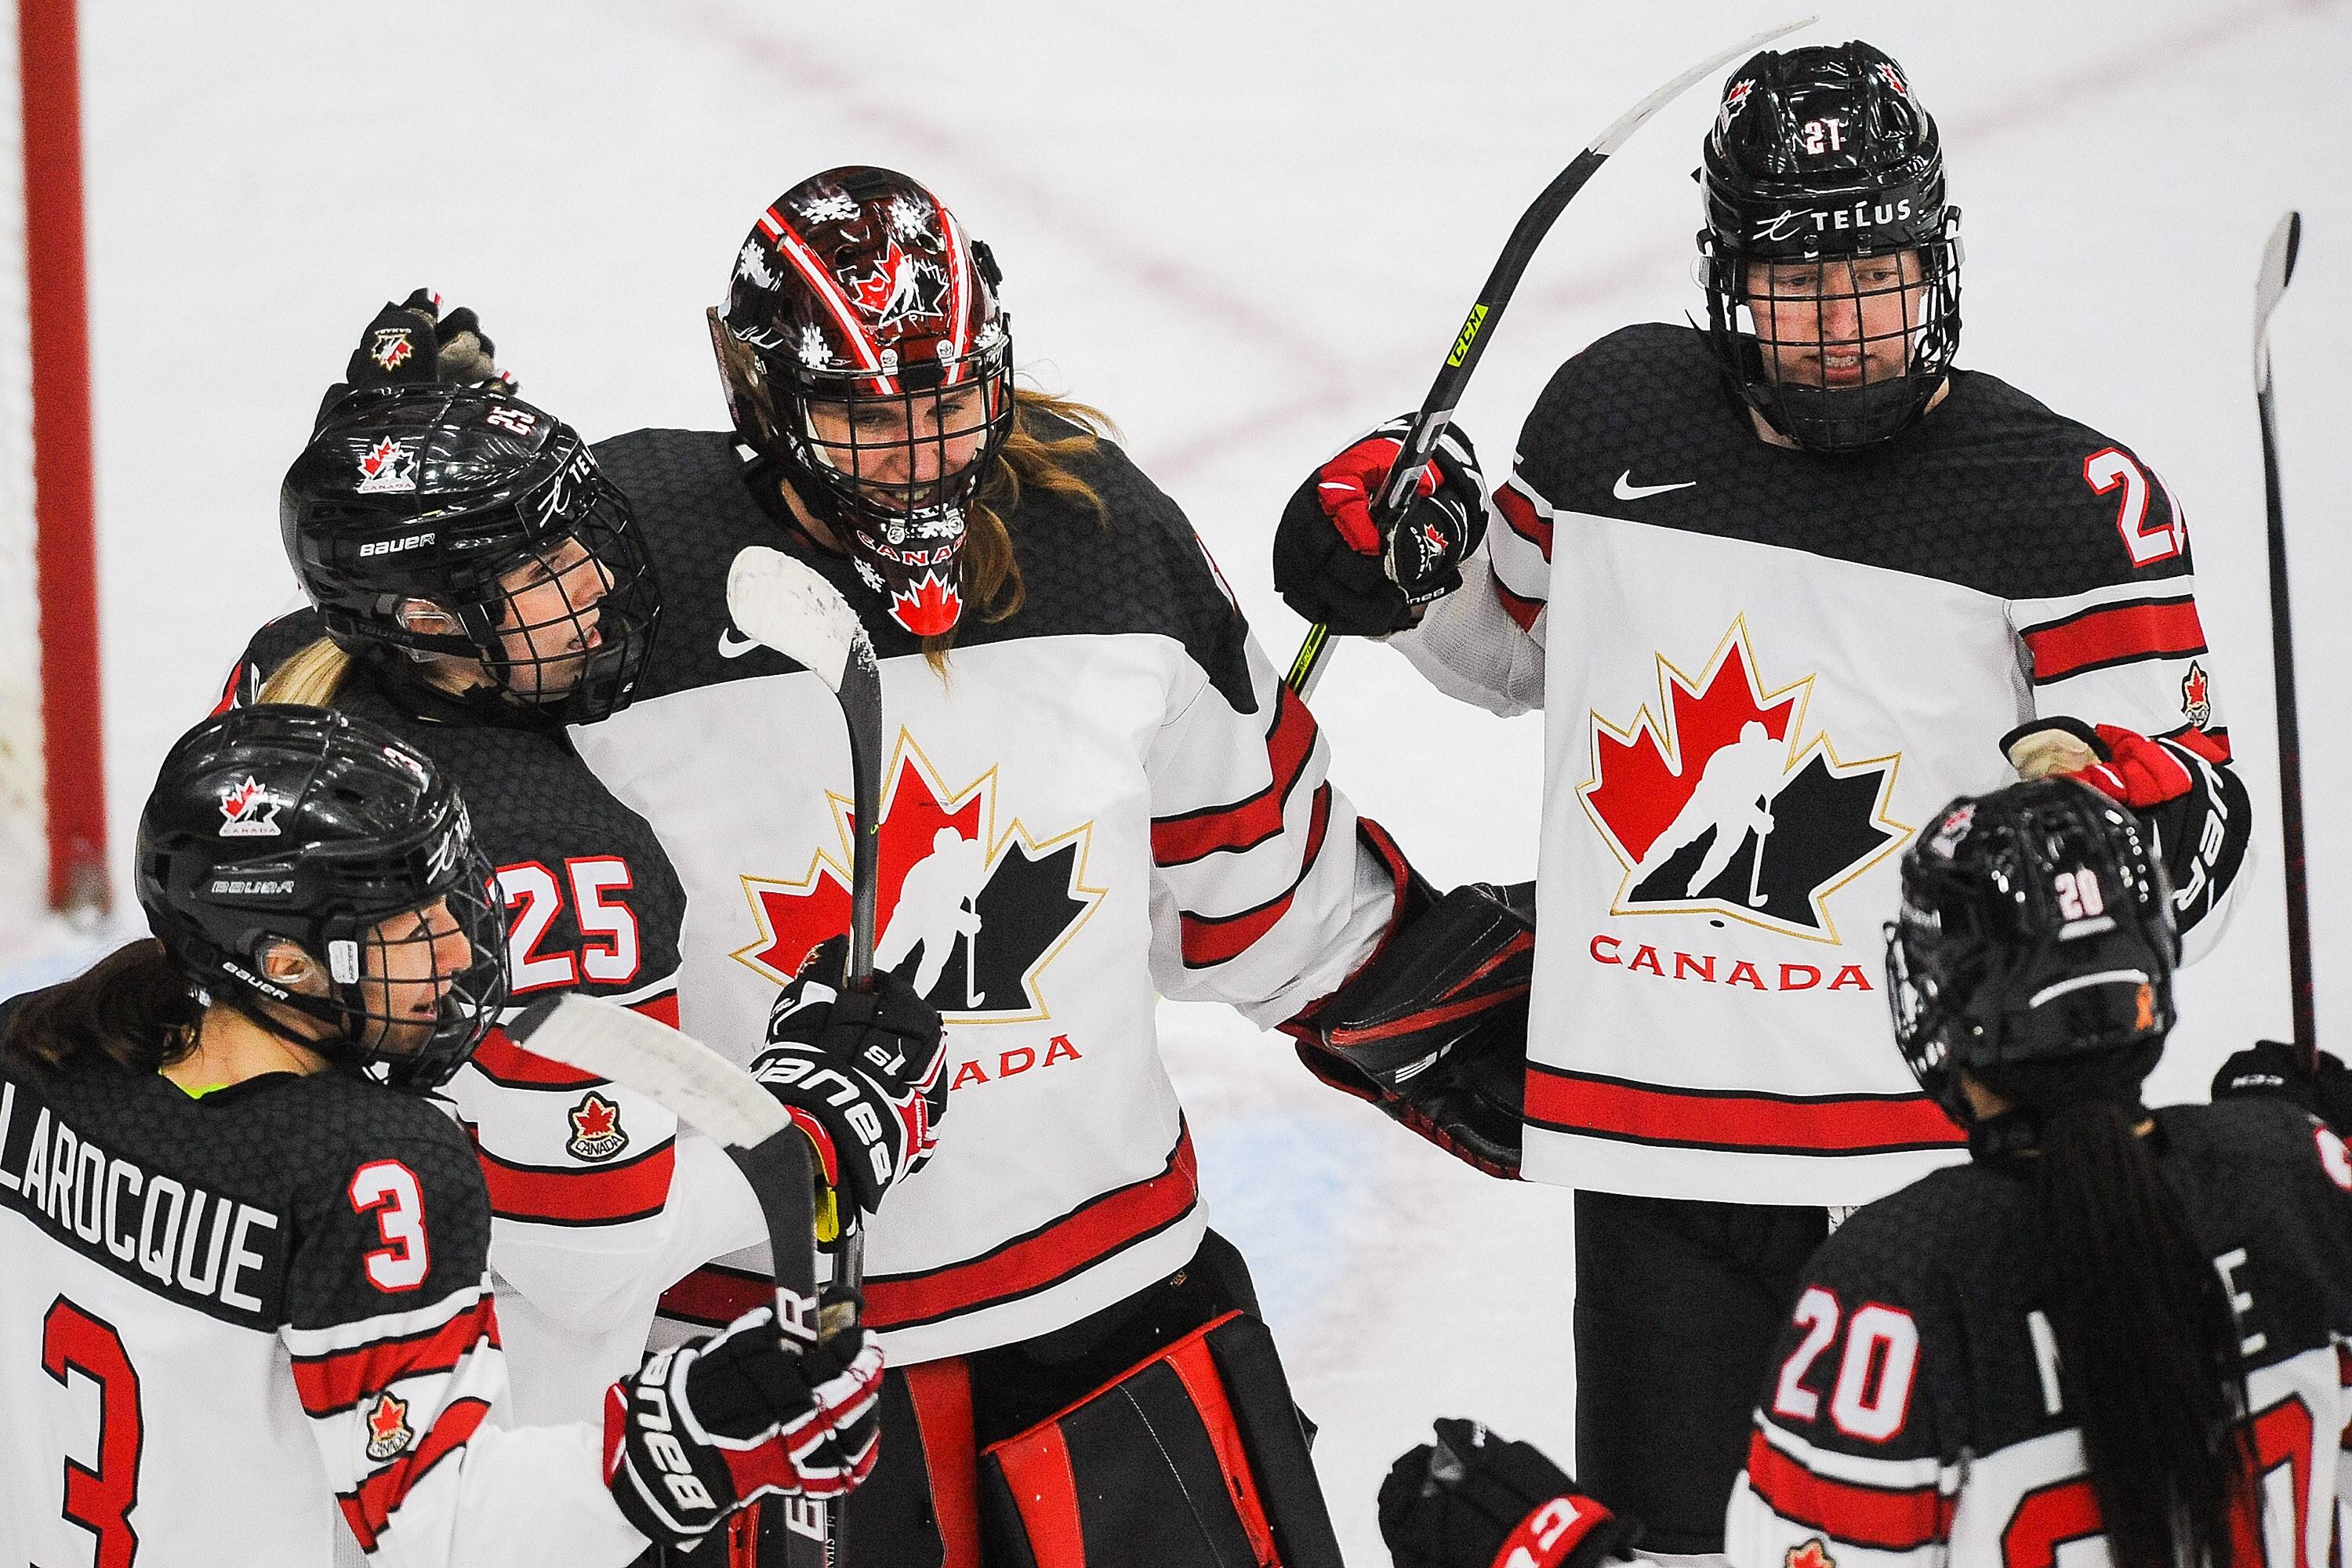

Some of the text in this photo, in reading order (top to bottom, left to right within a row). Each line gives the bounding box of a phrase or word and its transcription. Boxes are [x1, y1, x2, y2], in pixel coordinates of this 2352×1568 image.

[1811, 199, 1911, 232] TELUS
[1450, 308, 1483, 362] CCM
[359, 532, 436, 557] BAUER
[211, 880, 295, 895] BAUER
[2054, 867, 2104, 921] 20
[484, 854, 641, 996] 25
[223, 961, 290, 1001] BAUER
[1588, 934, 1875, 991] CANADA
[949, 1033, 1083, 1091] ADA
[575, 1134, 623, 1156] CANADA
[0, 1082, 278, 1313] LAROCQUE
[348, 1159, 431, 1294] 3
[1773, 1284, 1922, 1445] 20
[41, 1293, 144, 1568] 3
[635, 1353, 718, 1511] BAUE
